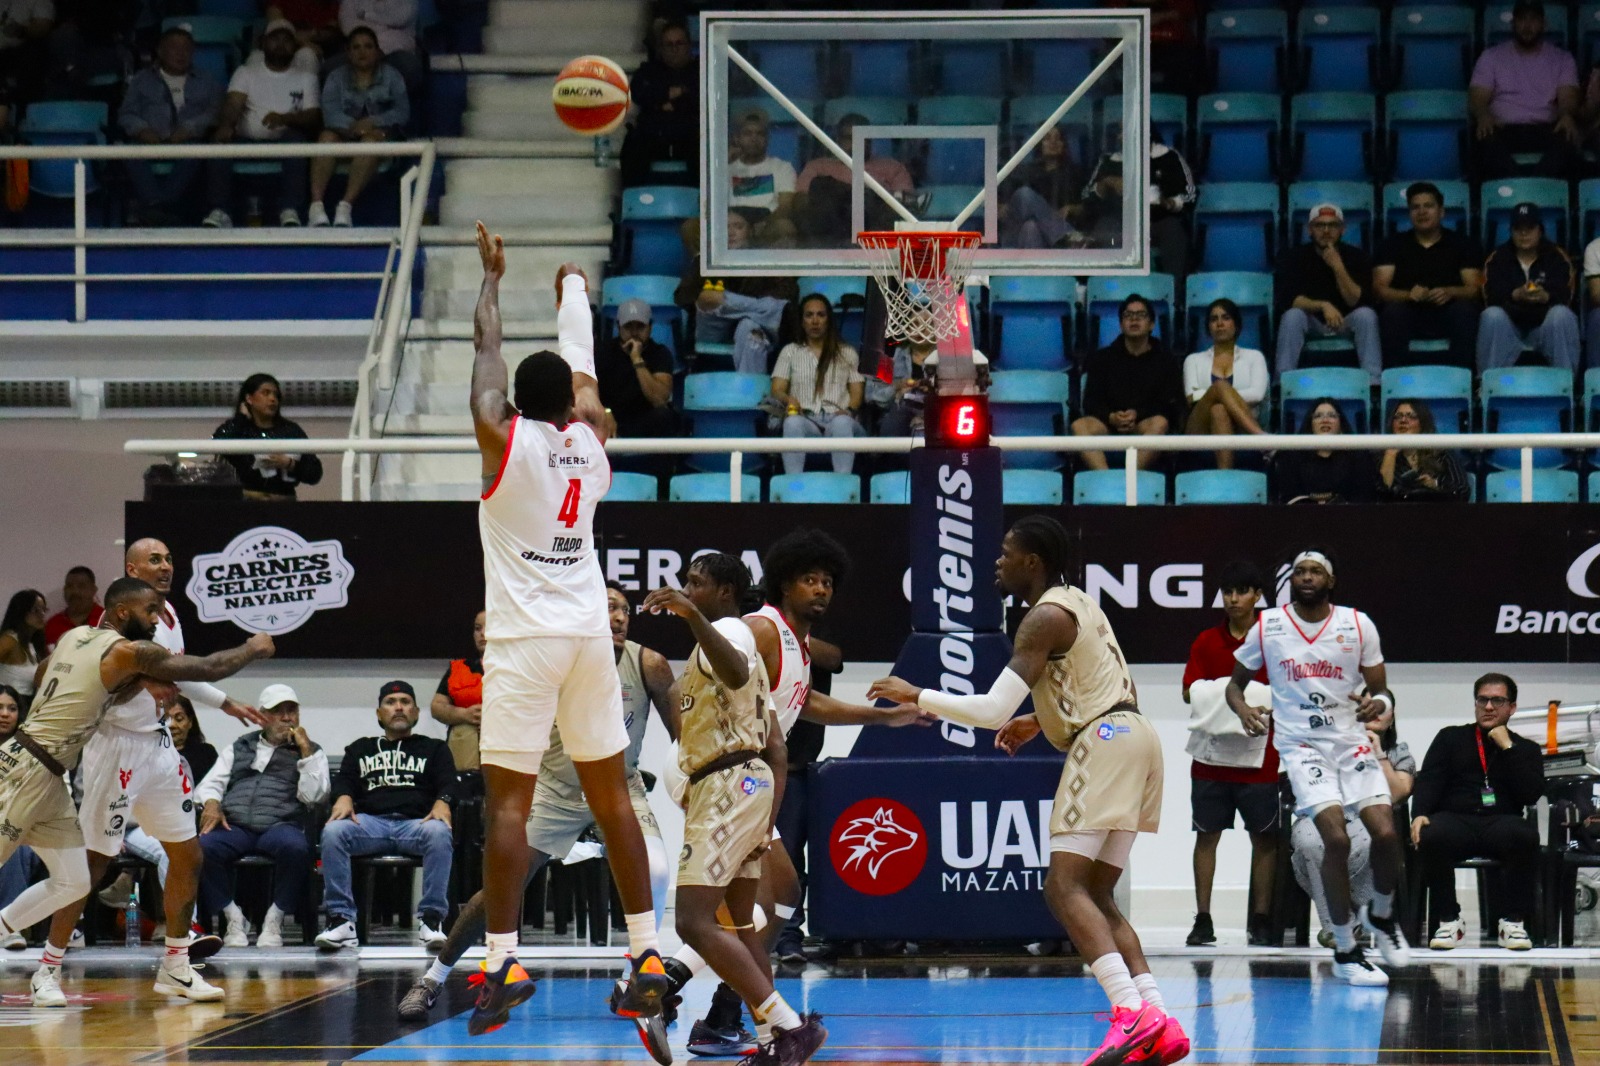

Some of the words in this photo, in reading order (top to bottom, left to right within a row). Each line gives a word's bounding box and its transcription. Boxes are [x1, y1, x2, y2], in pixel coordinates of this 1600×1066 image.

[956, 405, 975, 436] 6
[559, 456, 589, 465] HERS
[557, 478, 582, 529] 4
[256, 550, 277, 559] CSN
[552, 536, 583, 553] TRAPP
[205, 553, 330, 583] CARNES
[207, 571, 333, 598] SELECTAS
[225, 588, 317, 610] NAYARIT
[1495, 604, 1600, 635] Banco
[0, 750, 19, 768] ECATE
[359, 749, 428, 778] AMERICAN
[367, 774, 416, 791] EAGLE
[942, 870, 1044, 892] MAZATL
